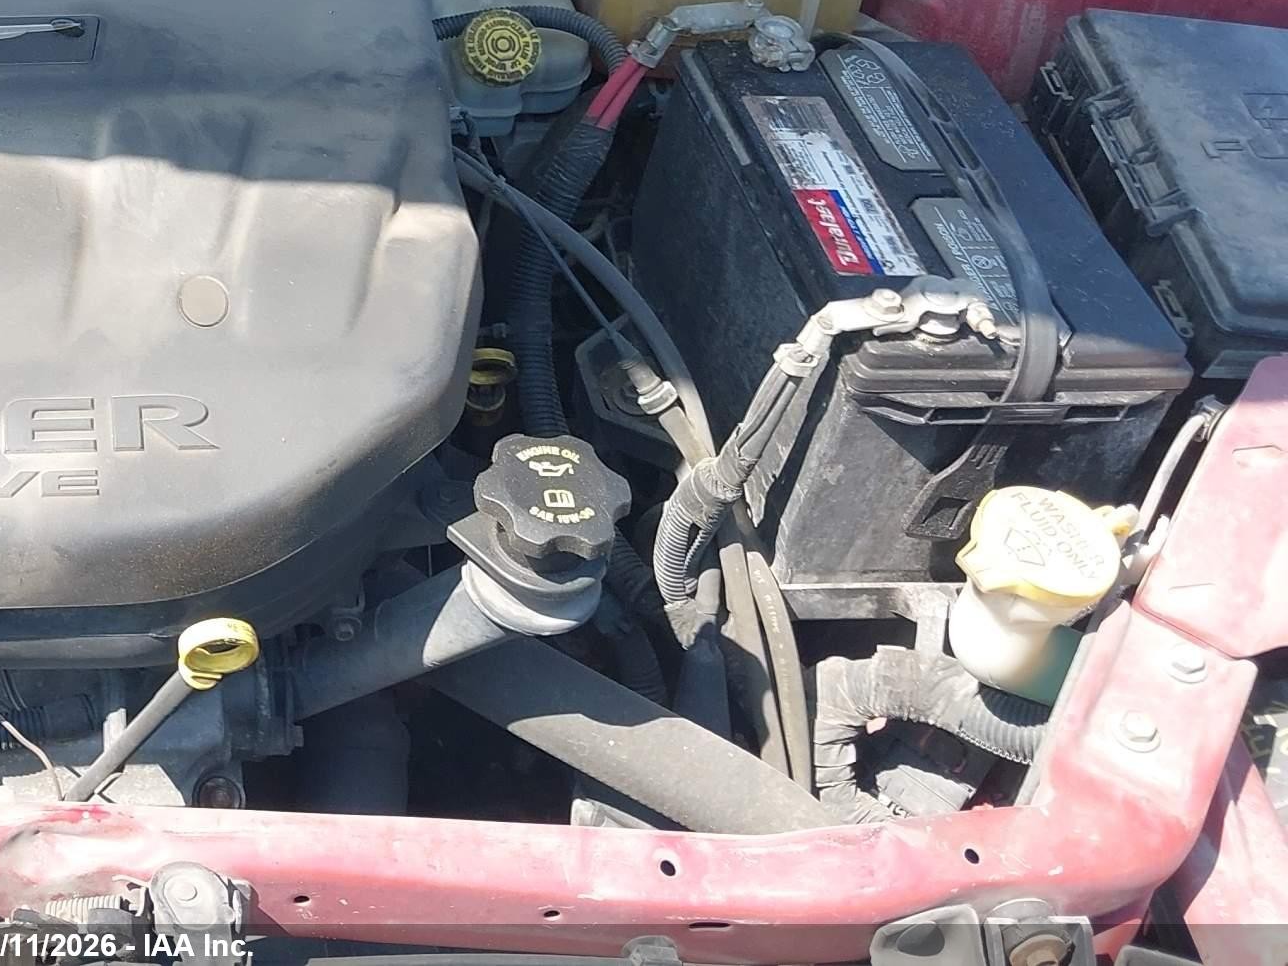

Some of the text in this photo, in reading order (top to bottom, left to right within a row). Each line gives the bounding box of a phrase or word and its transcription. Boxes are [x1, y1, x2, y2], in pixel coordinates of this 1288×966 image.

[807, 198, 859, 266] Duralast
[934, 221, 963, 259] POISON
[515, 445, 581, 464] ENGINE OIL
[528, 506, 554, 522] SAE
[1009, 491, 1099, 579] FLUID ONLY
